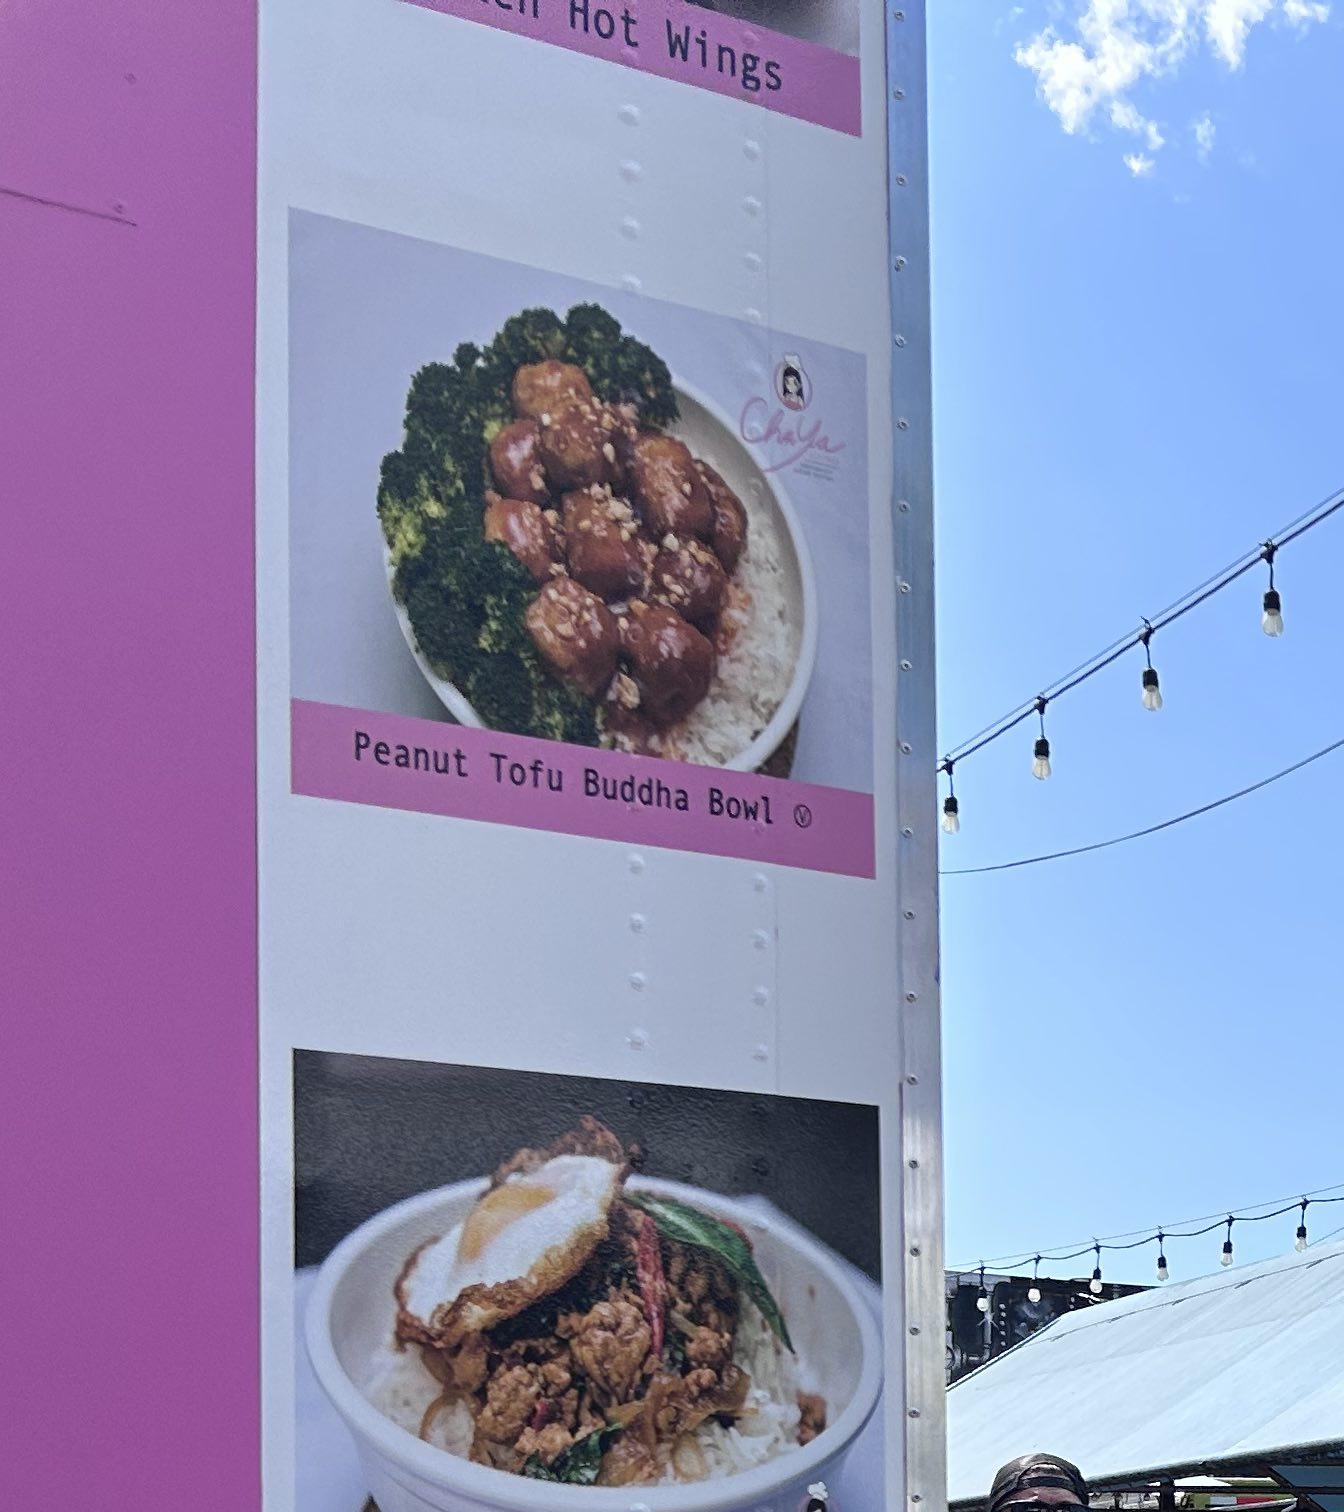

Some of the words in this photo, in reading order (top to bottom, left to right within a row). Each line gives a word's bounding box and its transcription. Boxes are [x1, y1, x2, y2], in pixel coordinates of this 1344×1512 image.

[569, 0, 640, 48] Hot
[665, 18, 783, 92] Wings
[353, 730, 469, 778] Peanut
[489, 751, 564, 793] Tofu
[584, 768, 690, 812] Buddha
[708, 786, 774, 825] Bowl
